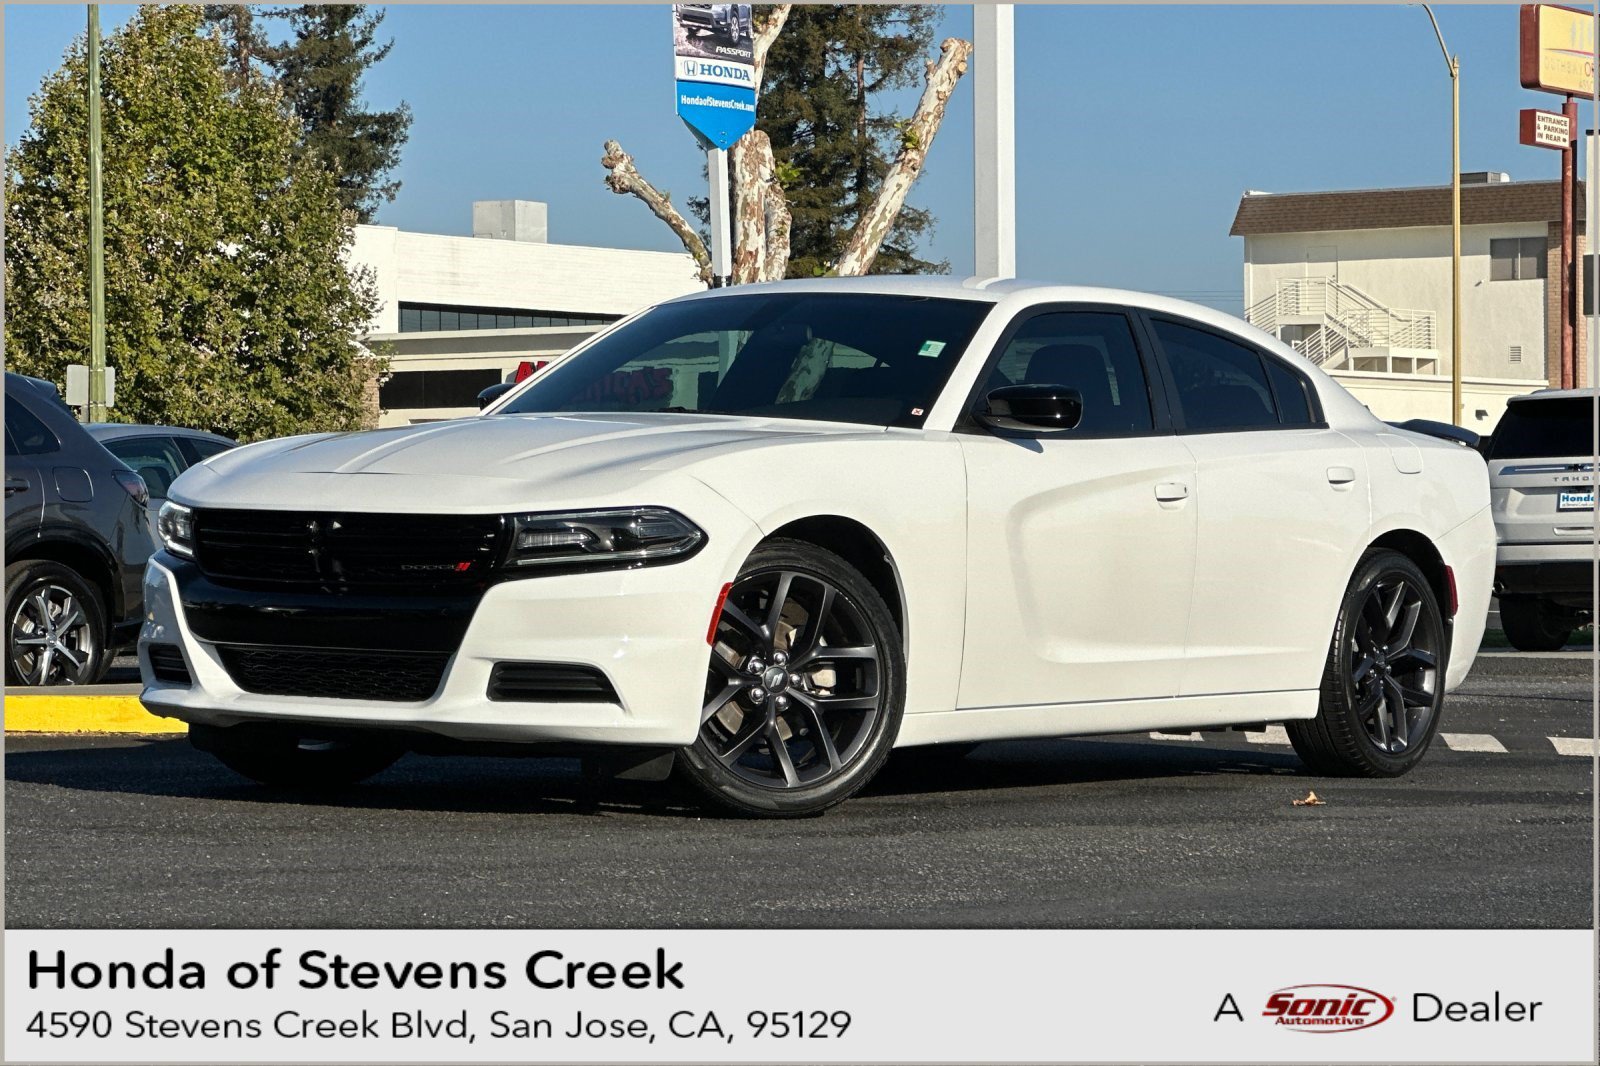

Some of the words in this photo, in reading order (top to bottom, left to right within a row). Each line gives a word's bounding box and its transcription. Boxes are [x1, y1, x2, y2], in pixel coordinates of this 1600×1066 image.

[715, 46, 751, 58] PASSPORT
[700, 64, 751, 81] HONDA
[681, 95, 755, 112] HondaofStevensCreek.com
[1537, 115, 1568, 126] ENTRANCE
[1543, 124, 1569, 136] PARKING
[1546, 134, 1561, 142] REAR
